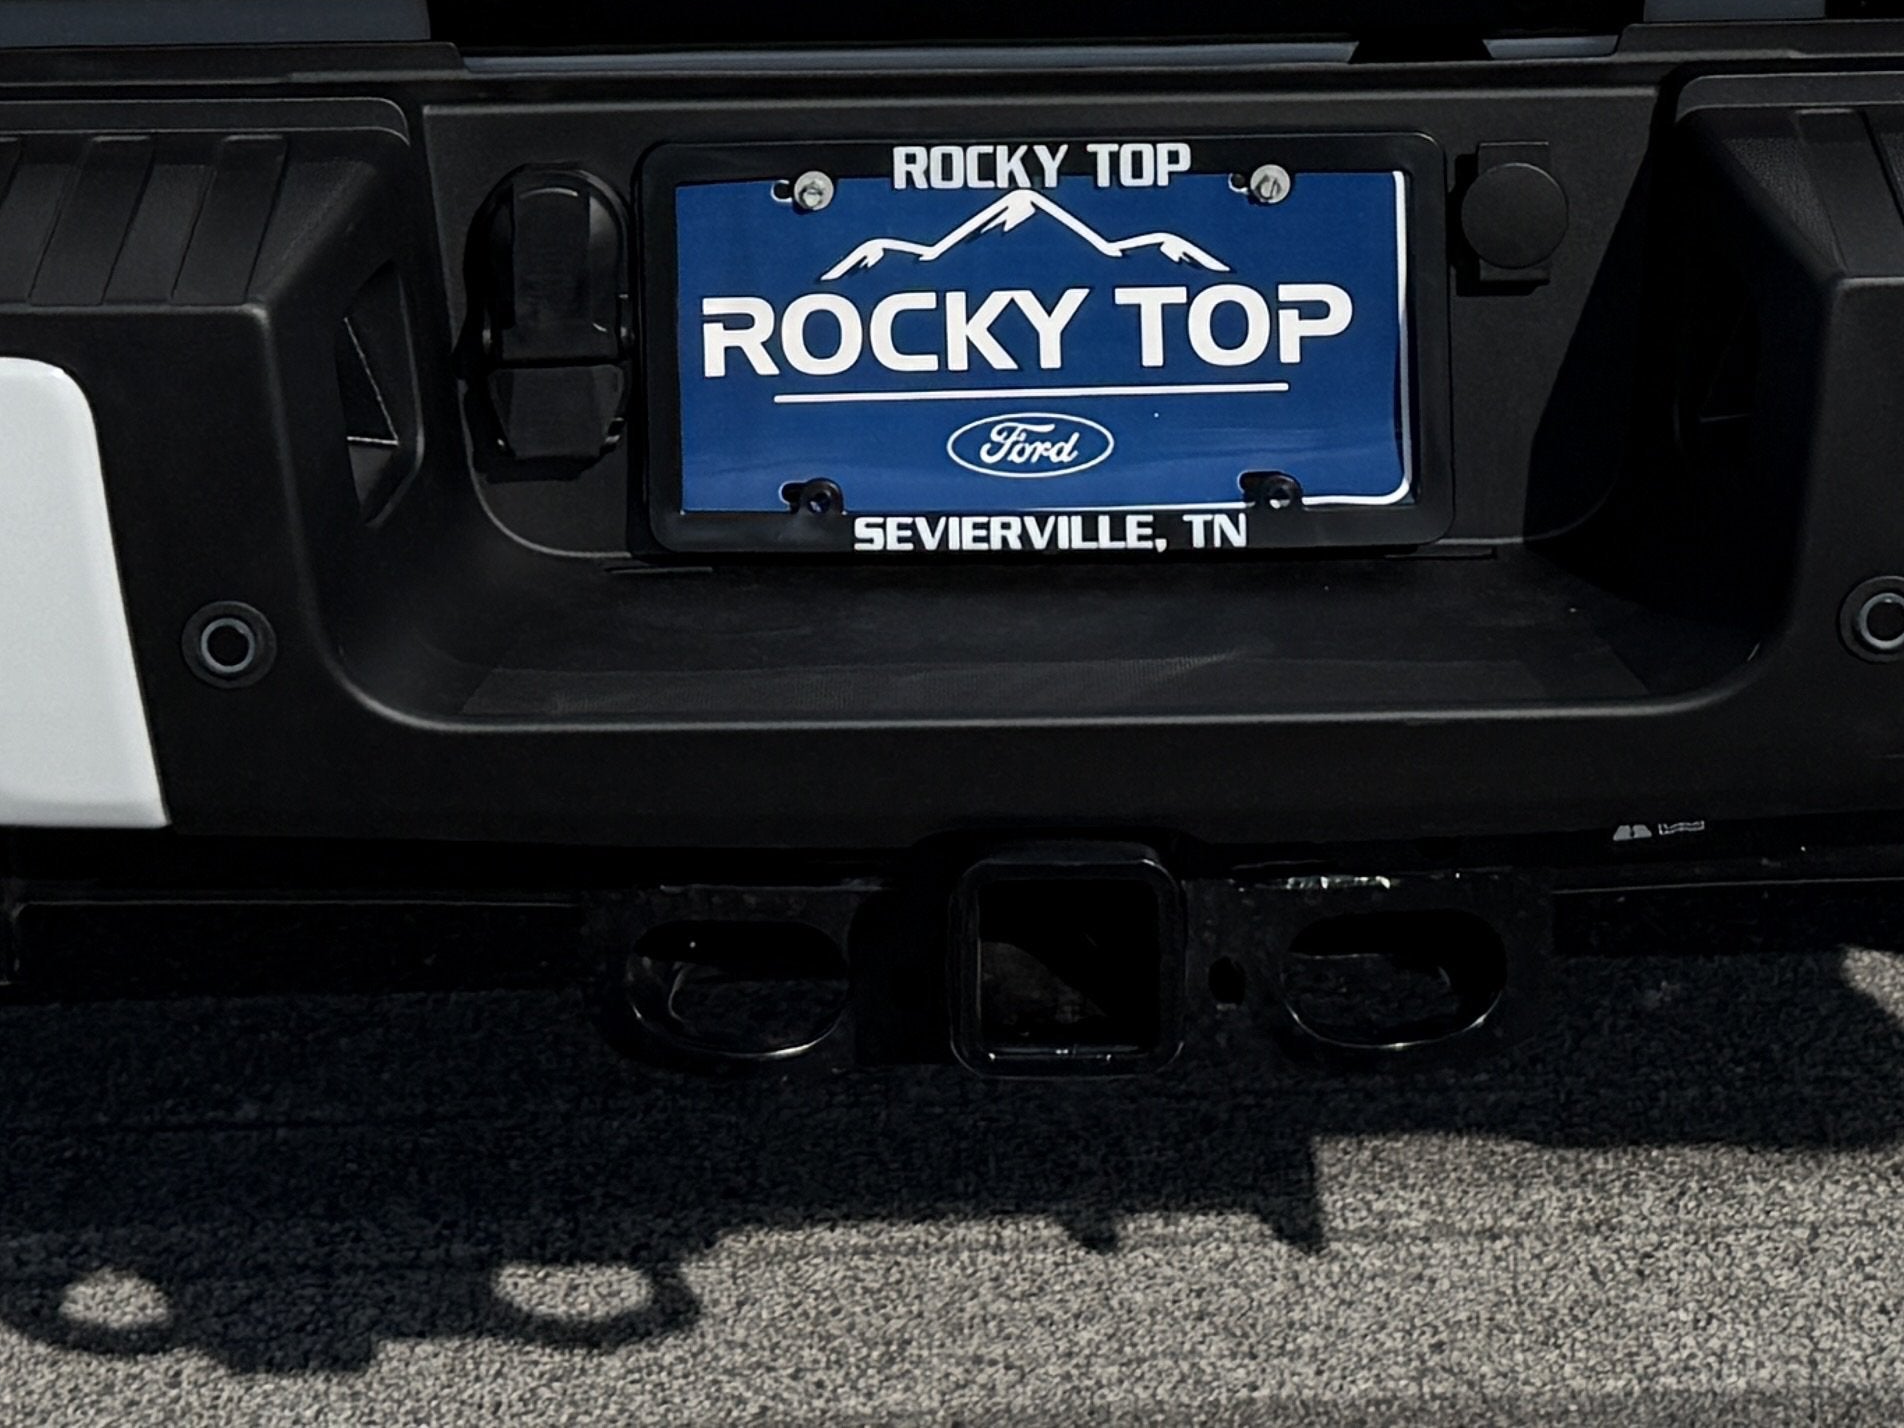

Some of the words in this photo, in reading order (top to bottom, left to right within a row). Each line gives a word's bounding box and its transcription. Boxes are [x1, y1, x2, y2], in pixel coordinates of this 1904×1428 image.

[892, 143, 1069, 190] ROCKY
[1086, 142, 1192, 188] TOP
[702, 288, 1090, 378] ROCKY
[1114, 283, 1353, 367] TOP
[979, 421, 1080, 464] Ford
[853, 515, 1169, 553] SEVIERVILLE,
[1182, 512, 1247, 550] TN
